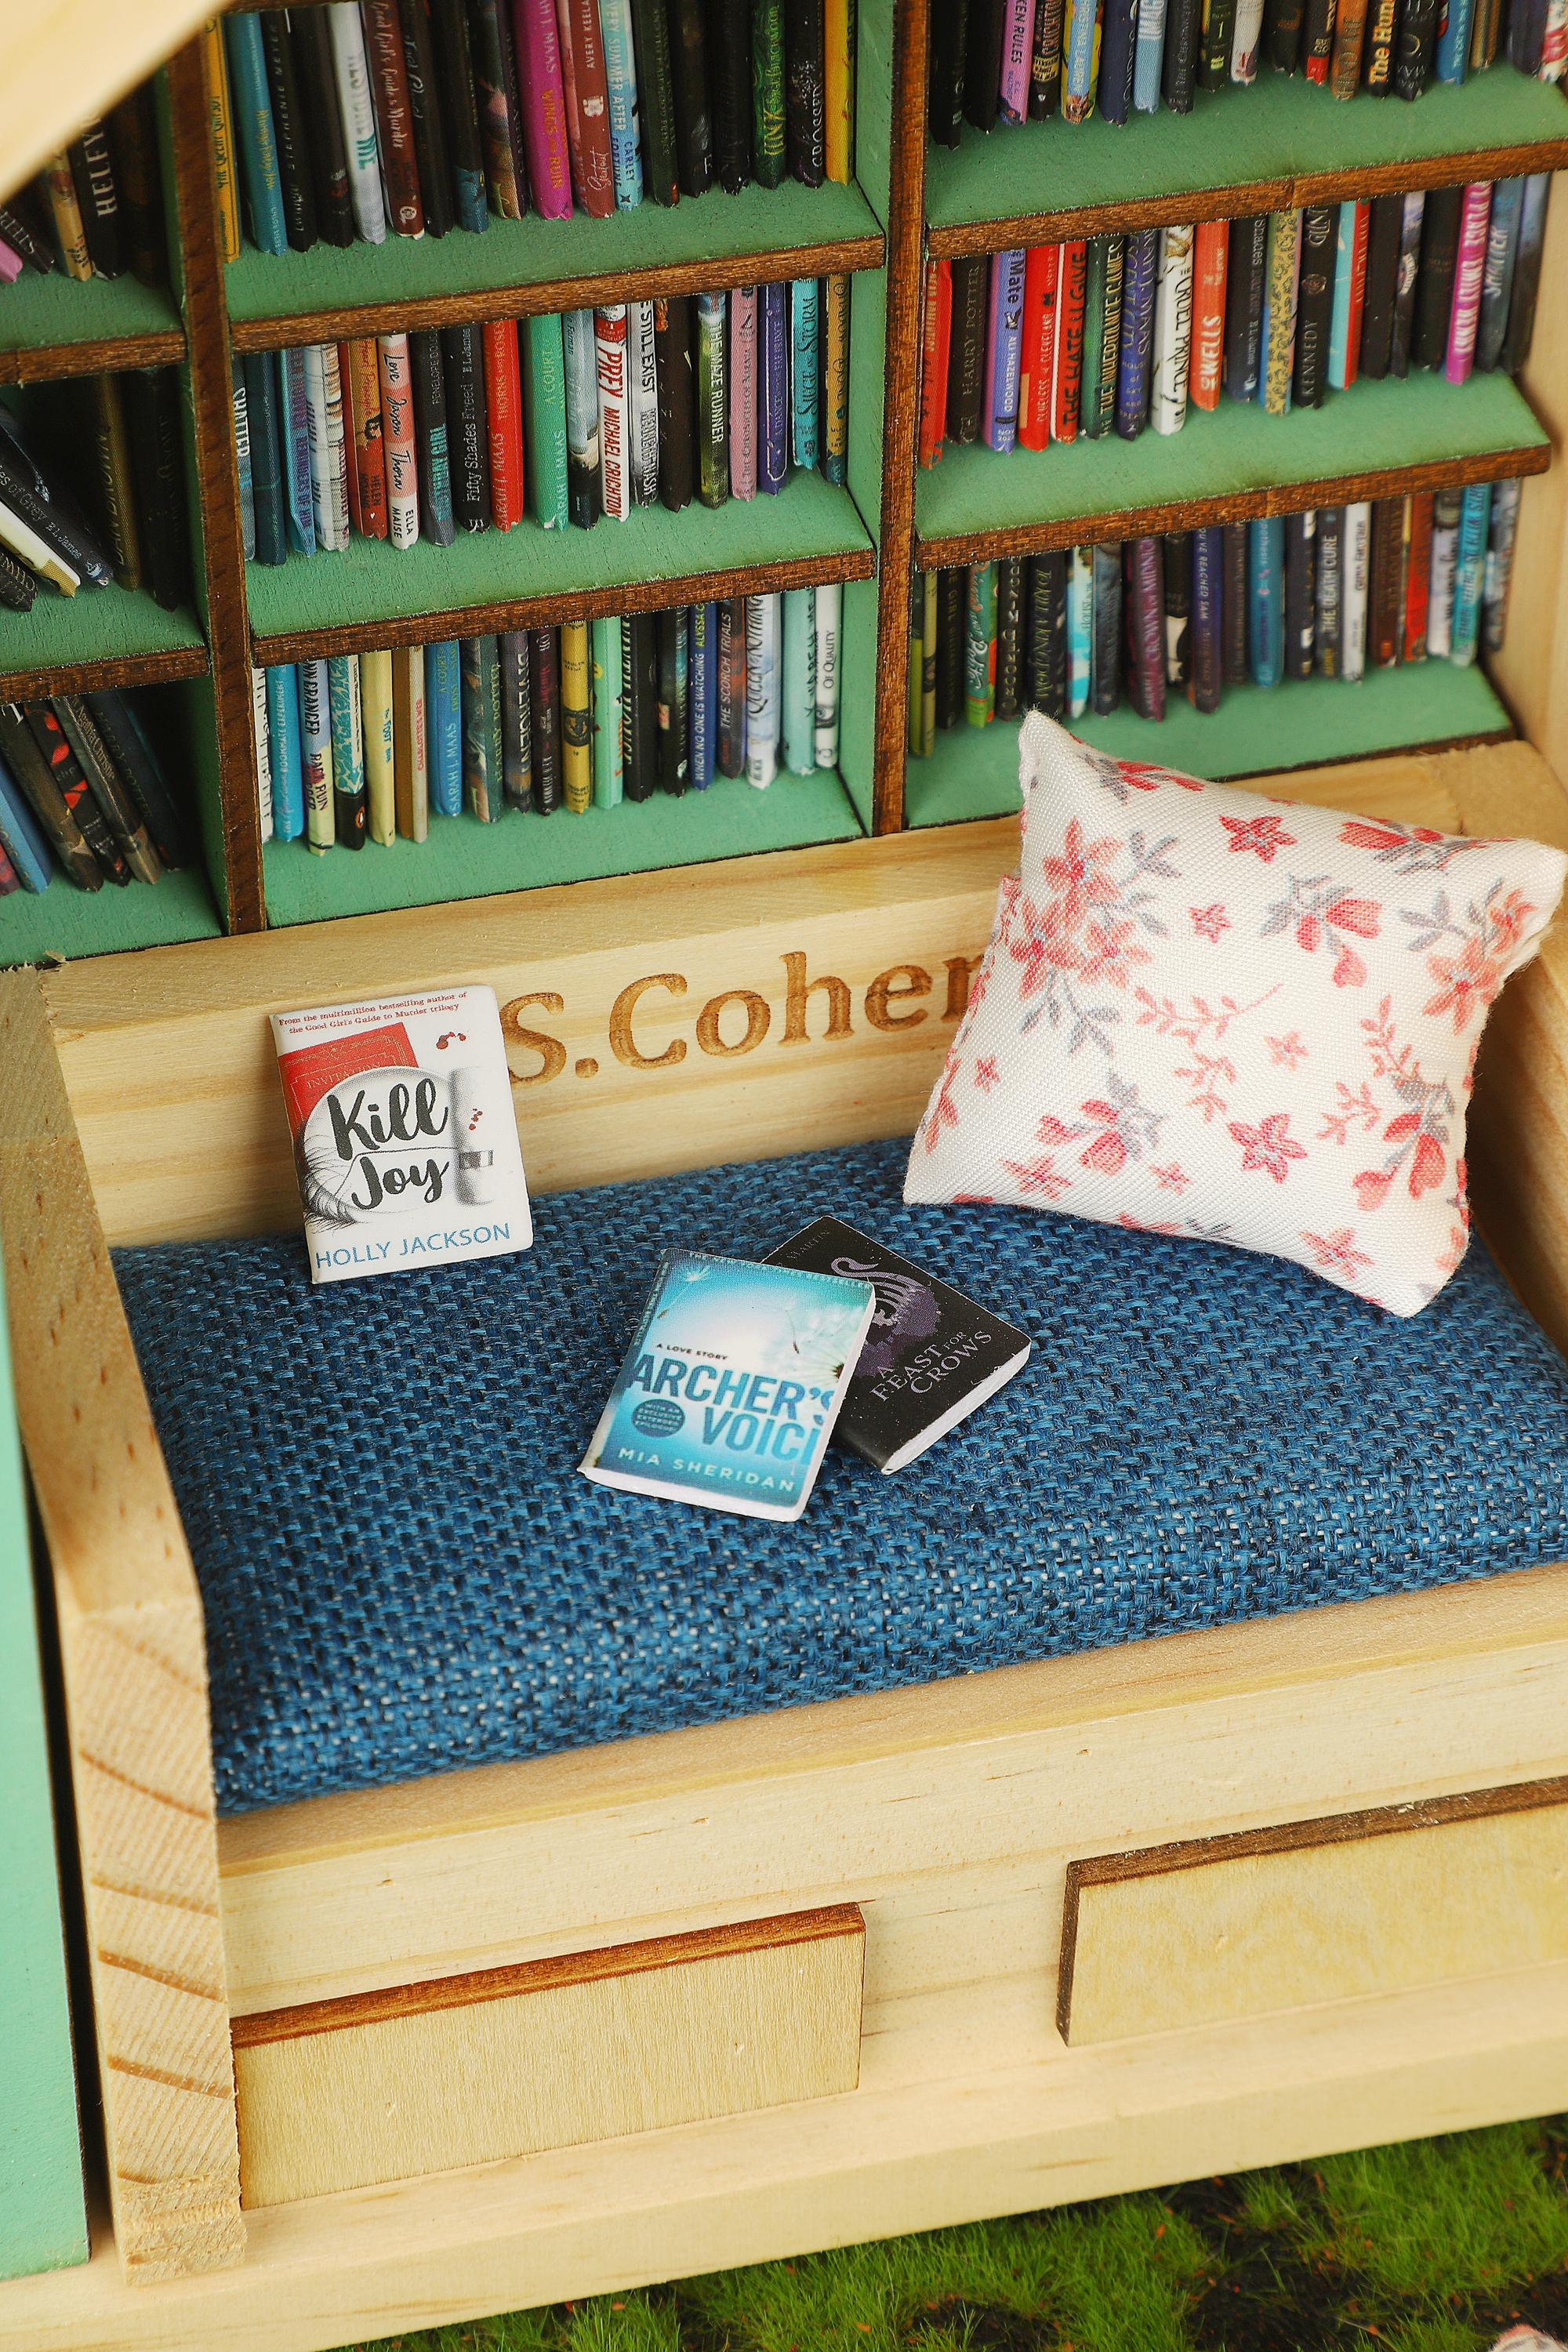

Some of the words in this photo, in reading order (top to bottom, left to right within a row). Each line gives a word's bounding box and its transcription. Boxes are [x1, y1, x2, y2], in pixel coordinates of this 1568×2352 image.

[544, 31, 557, 74] MAAS
[585, 36, 596, 70] AVERY
[606, 36, 624, 95] SUMMER
[1011, 24, 1025, 64] RULES
[1073, 49, 1087, 93] LAUREN
[1369, 48, 1390, 84] The
[541, 88, 558, 136] WINGS
[611, 96, 628, 132] AFTER
[549, 156, 564, 190] RUIN
[612, 136, 622, 188] FORTUNE
[624, 140, 636, 181] CARLEY
[1252, 218, 1266, 266] Shades
[1306, 207, 1331, 248] GLINT
[1069, 251, 1087, 302] GIVE
[1105, 243, 1124, 294] GAMES
[965, 265, 980, 328] POTTER
[1174, 276, 1192, 331] CRUEL
[566, 326, 576, 356] Forman
[639, 313, 655, 353] STILL
[710, 322, 723, 350] THE
[774, 321, 783, 352] PRINCE
[797, 294, 818, 354] STORM
[1007, 336, 1017, 350] ALI
[1040, 313, 1054, 365] CLEVELAND
[1101, 298, 1123, 384] INHERITANCE
[1138, 294, 1155, 355] MAAS
[1200, 314, 1222, 374] WELLS
[1454, 308, 1479, 354] HENRY
[383, 353, 405, 384] Love
[597, 345, 624, 399] PREY
[641, 353, 655, 394] EXIST
[710, 353, 724, 389] MAZE
[962, 336, 975, 396] HARRY
[1065, 328, 1083, 382] HATE
[1167, 332, 1190, 393] PRINCE
[1301, 318, 1319, 396] KENNEDY
[461, 383, 474, 420] Freed
[495, 376, 508, 420] THORNS
[797, 369, 818, 416] SIEGE
[1004, 352, 1018, 412] HAZELWOOD
[1036, 379, 1051, 423] CLUELESS
[1100, 387, 1116, 416] THE
[385, 395, 408, 437] Jason
[710, 390, 724, 445] RUNNER
[1063, 388, 1081, 426] THE
[430, 423, 448, 456] GIRL
[463, 423, 480, 470] Shades
[489, 432, 504, 471] MAAS
[603, 404, 620, 456] MICHAEL
[389, 449, 412, 490] Thorn
[463, 472, 481, 503] Fifty
[604, 459, 622, 518] CRICHTON
[642, 463, 657, 495] NASH
[391, 506, 403, 539] MAISE
[405, 508, 415, 535] ELLA
[494, 485, 507, 531] SARAH
[1323, 535, 1338, 567] CURE
[1198, 556, 1210, 597] REACHED
[1323, 570, 1338, 607] DEATH
[747, 596, 764, 657] NOTHING
[946, 590, 958, 621] GIRL
[1199, 600, 1209, 620] SAM
[1320, 609, 1337, 634] THE
[695, 613, 706, 648] ALYSSA
[720, 612, 734, 655] TRIALS
[822, 630, 837, 673] QUALITY
[1142, 607, 1160, 662] CROWN
[437, 655, 448, 685] COURT
[695, 652, 705, 700] WATCHING
[719, 655, 733, 709] SCORCH
[1001, 629, 1018, 709] CROOKED
[1032, 626, 1054, 699] KINGDOM
[274, 679, 286, 729] EXPERIMENT
[303, 680, 321, 735] GRANGER
[490, 662, 501, 722] POTTER
[517, 649, 532, 774] DIVERGENT
[695, 702, 705, 712] IS
[383, 720, 392, 742] FOOT
[445, 722, 459, 757] MAAS
[695, 713, 705, 734] ONE
[719, 709, 733, 729] THE
[276, 730, 289, 774] ROOMMATE
[492, 726, 503, 783] HARRY
[694, 735, 705, 751] NO
[694, 752, 705, 782] WHEN
[314, 785, 328, 812] RUIN
[446, 770, 462, 812] SARAH
[278, 1016, 301, 1027] From
[303, 1013, 318, 1022] the
[379, 998, 425, 1012] bestselling
[426, 993, 456, 1004] author
[458, 990, 468, 1000] of
[289, 1026, 304, 1035] the
[305, 1022, 328, 1032] Good
[354, 1014, 382, 1025] Guide
[383, 1012, 394, 1021] to
[395, 1007, 428, 1019] Murder
[430, 1003, 461, 1014] trilogy
[326, 1077, 450, 1162] Kill
[350, 1156, 450, 1211] Joy
[314, 1241, 392, 1270] HOLLY
[398, 1221, 512, 1258] JACKSON
[666, 1345, 692, 1355] LOVE
[696, 1350, 728, 1361] STORY
[869, 1343, 944, 1403] FEAST
[942, 1330, 967, 1350] FOR
[876, 1364, 895, 1380] A
[909, 1330, 993, 1396] CROWS
[701, 1406, 821, 1468] VOIC
[617, 1447, 661, 1468] MIA
[672, 1457, 798, 1494] SHERIDAN
